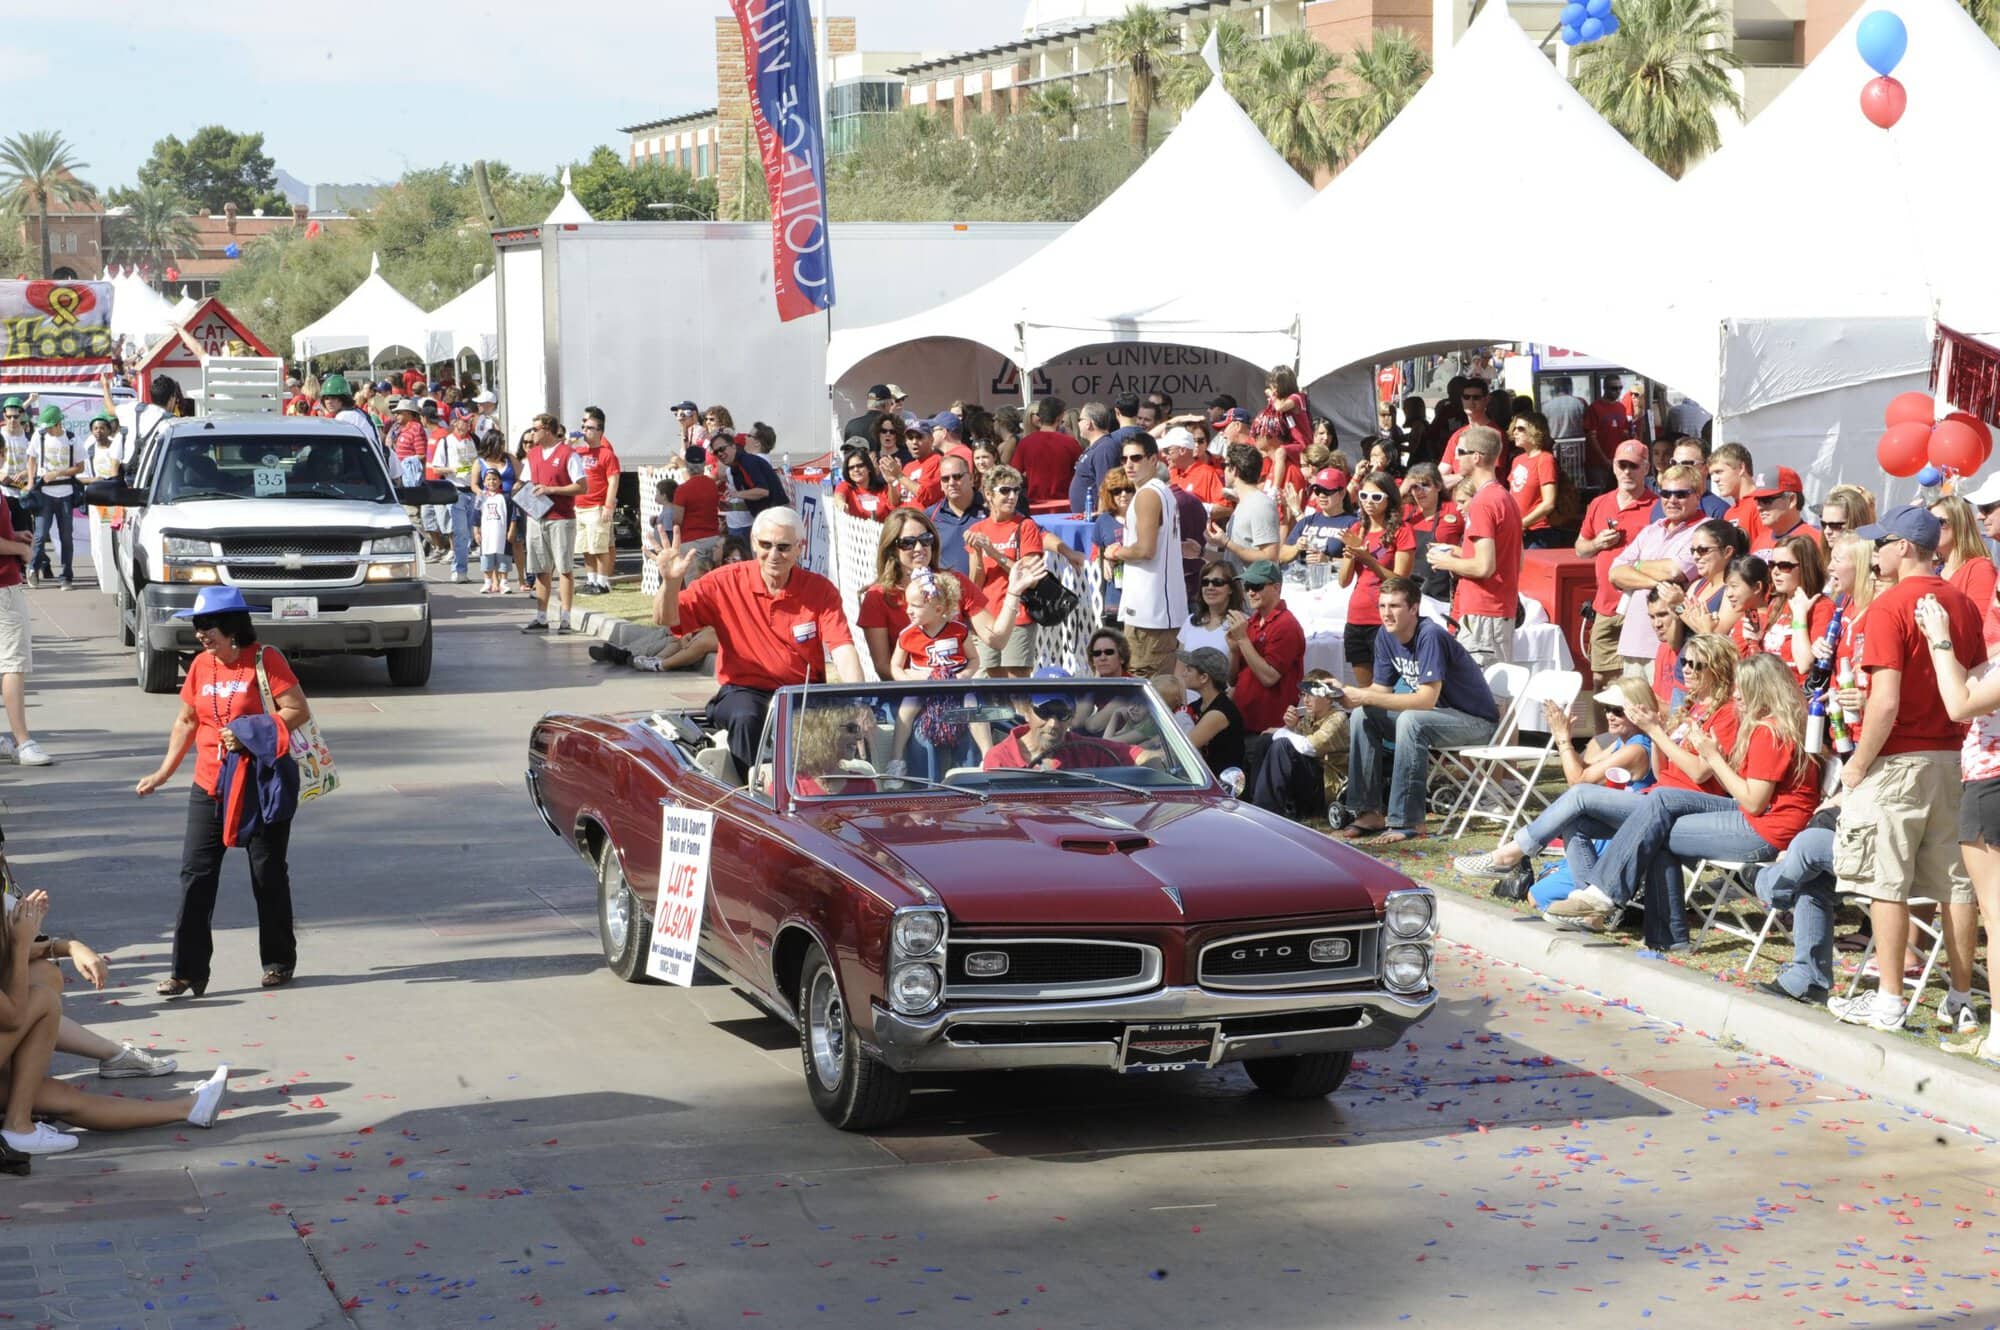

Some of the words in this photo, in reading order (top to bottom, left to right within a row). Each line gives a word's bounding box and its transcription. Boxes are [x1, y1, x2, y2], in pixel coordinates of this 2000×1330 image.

[193, 323, 227, 340] CAT
[1071, 374, 1102, 395] OF
[1107, 371, 1214, 395] ARIZONA
[257, 473, 284, 487] 35
[689, 818, 706, 837] Sports
[670, 836, 680, 852] Hall
[686, 838, 701, 857] Fame
[667, 861, 698, 899] LUTE
[657, 901, 697, 941] OLSON
[1231, 945, 1292, 960] GTO
[1146, 1063, 1186, 1073] GTO
